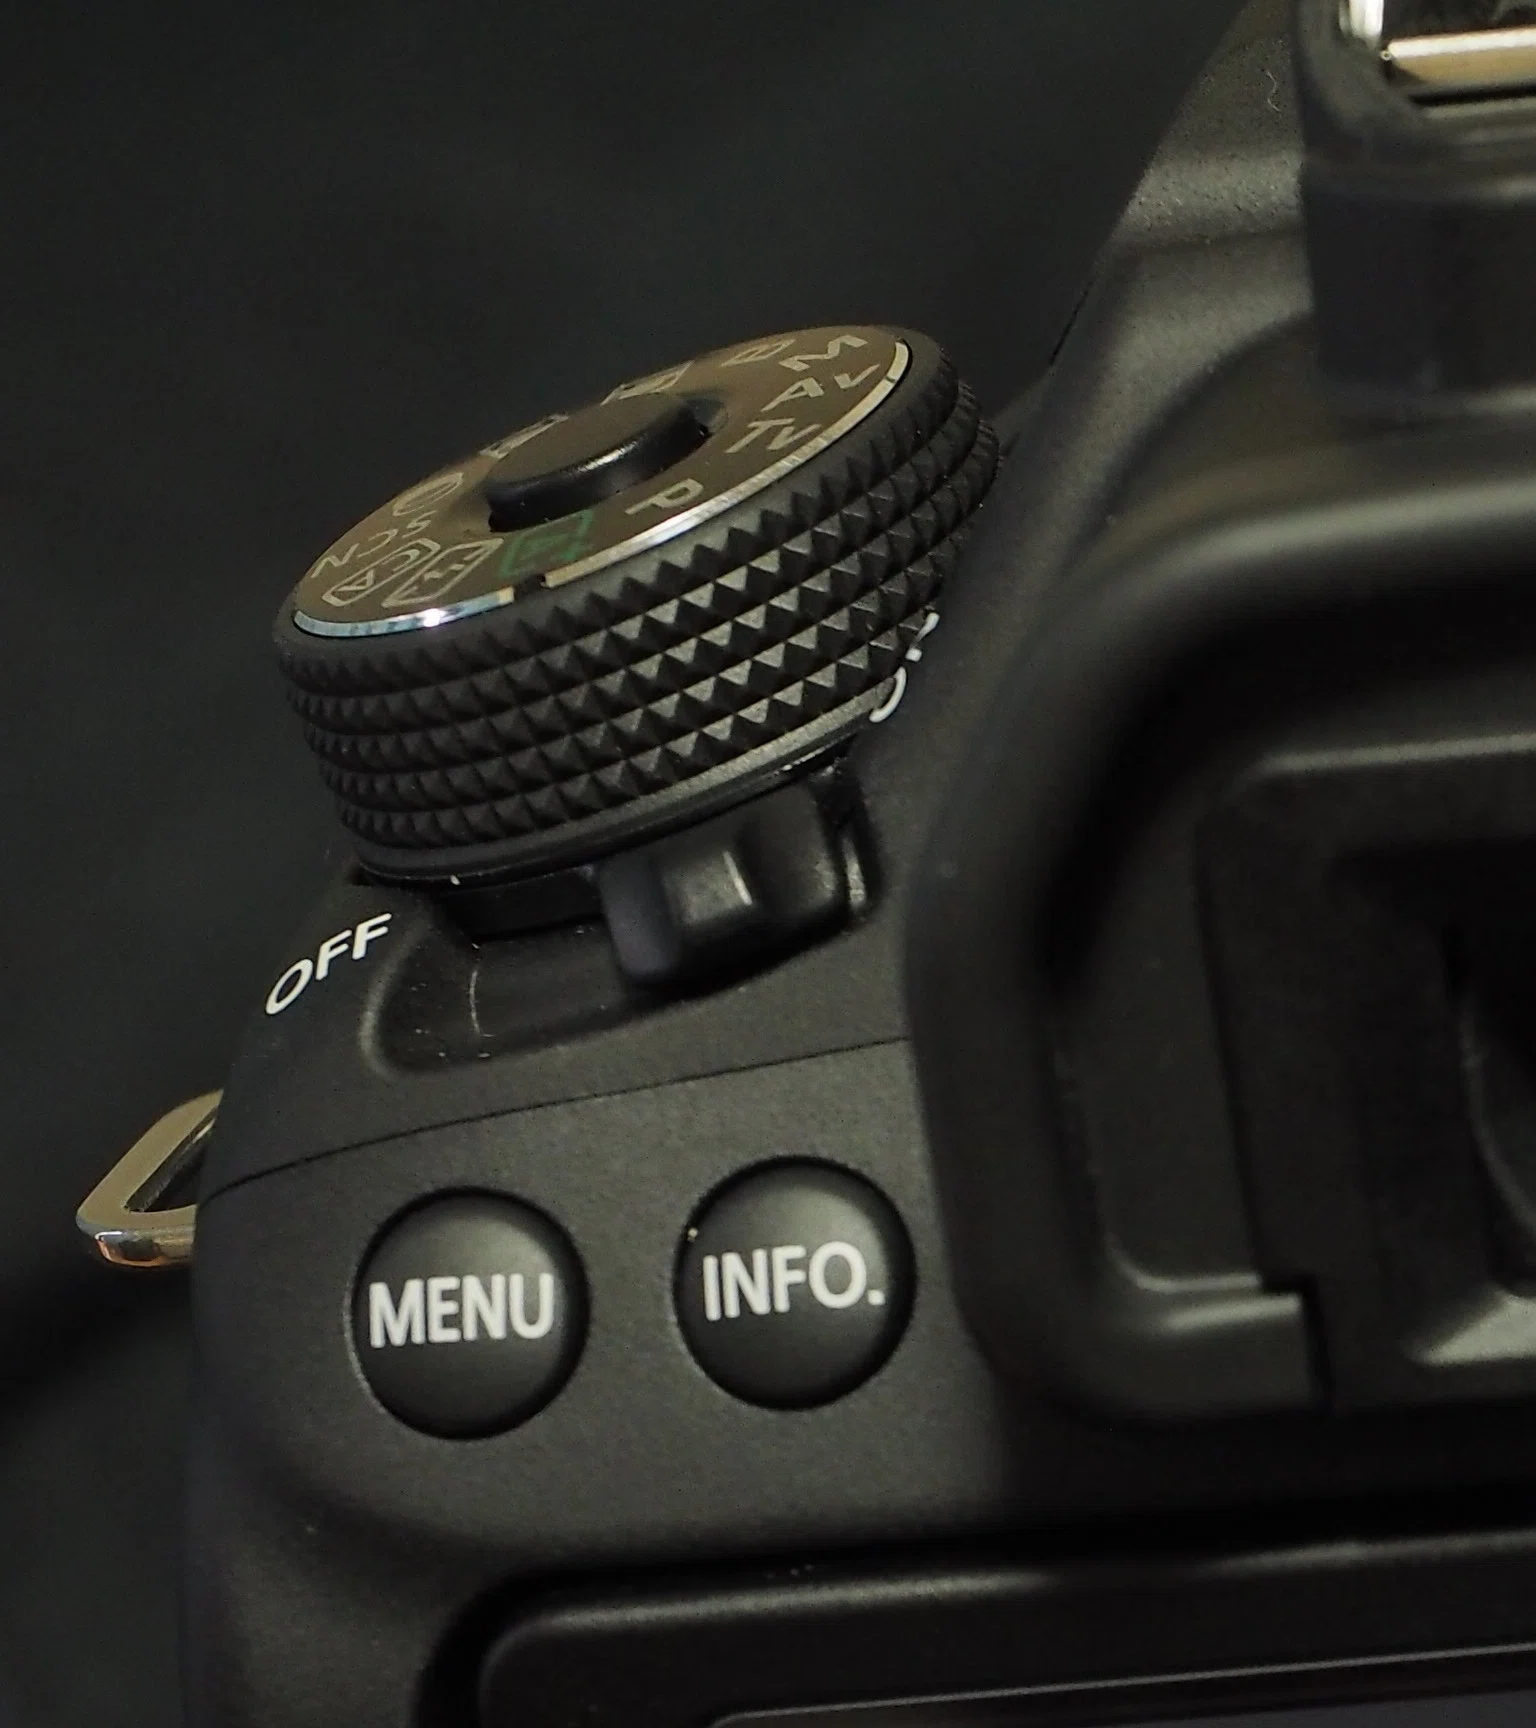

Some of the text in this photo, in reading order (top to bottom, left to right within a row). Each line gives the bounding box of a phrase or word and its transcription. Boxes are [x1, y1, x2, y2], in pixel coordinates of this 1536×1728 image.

[625, 478, 704, 515] P
[265, 912, 392, 1016] OFF
[368, 1272, 555, 1348] MENU
[703, 1241, 886, 1321] INFO.
